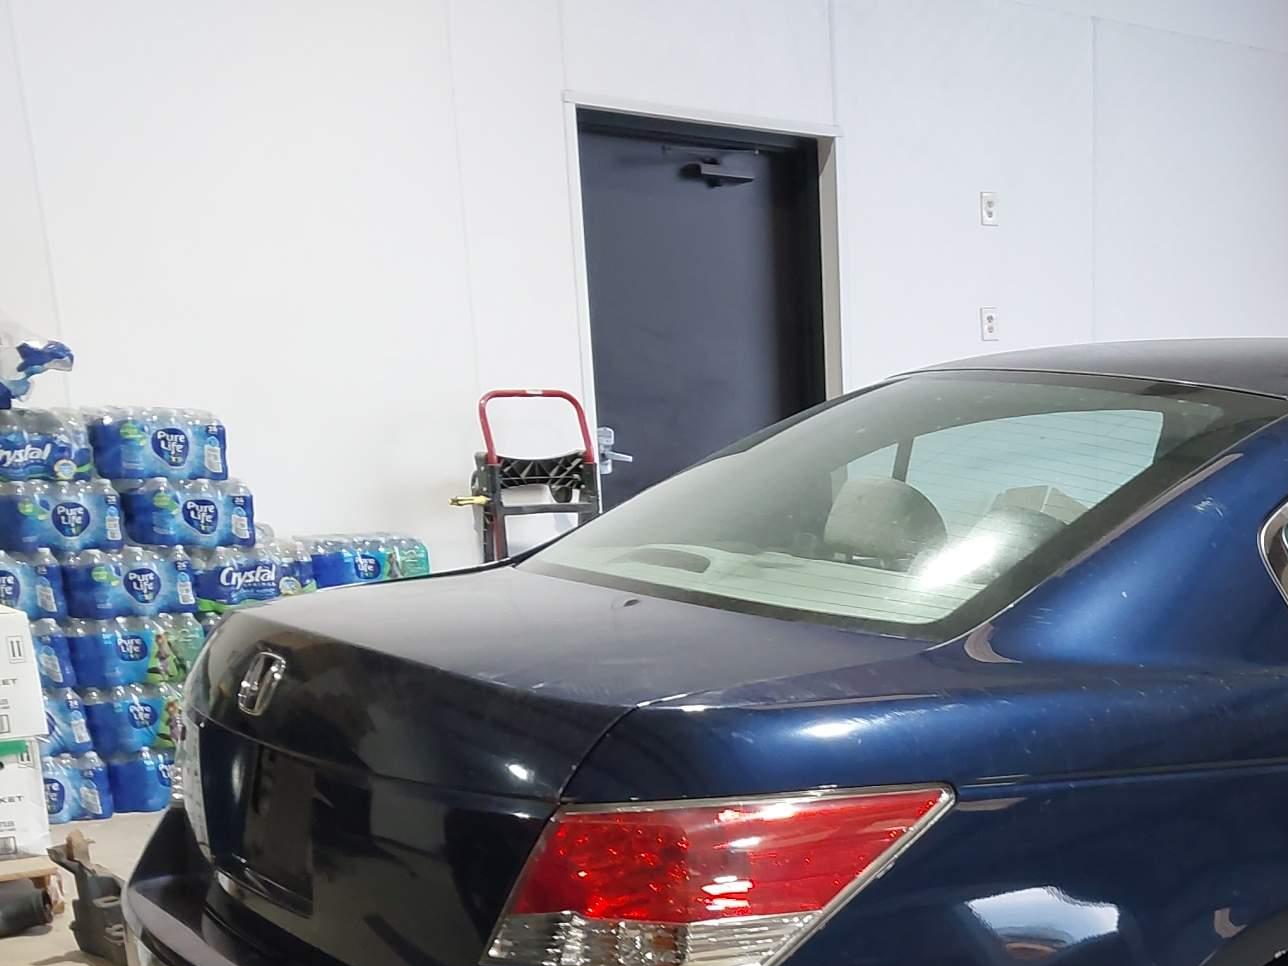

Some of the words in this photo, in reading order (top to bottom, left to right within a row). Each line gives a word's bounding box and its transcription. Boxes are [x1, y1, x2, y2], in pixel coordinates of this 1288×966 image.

[157, 430, 185, 442] Pure
[160, 439, 184, 455] Life
[0, 443, 52, 467] rystal
[57, 505, 84, 515] Pure
[186, 501, 215, 512] Pure
[60, 515, 82, 527] Life
[190, 510, 213, 523] Life
[0, 575, 14, 584] re
[128, 572, 154, 582] Pure
[220, 563, 276, 590] Crystal
[132, 581, 154, 593] Life
[117, 638, 142, 647] Pure
[121, 644, 141, 654] Life
